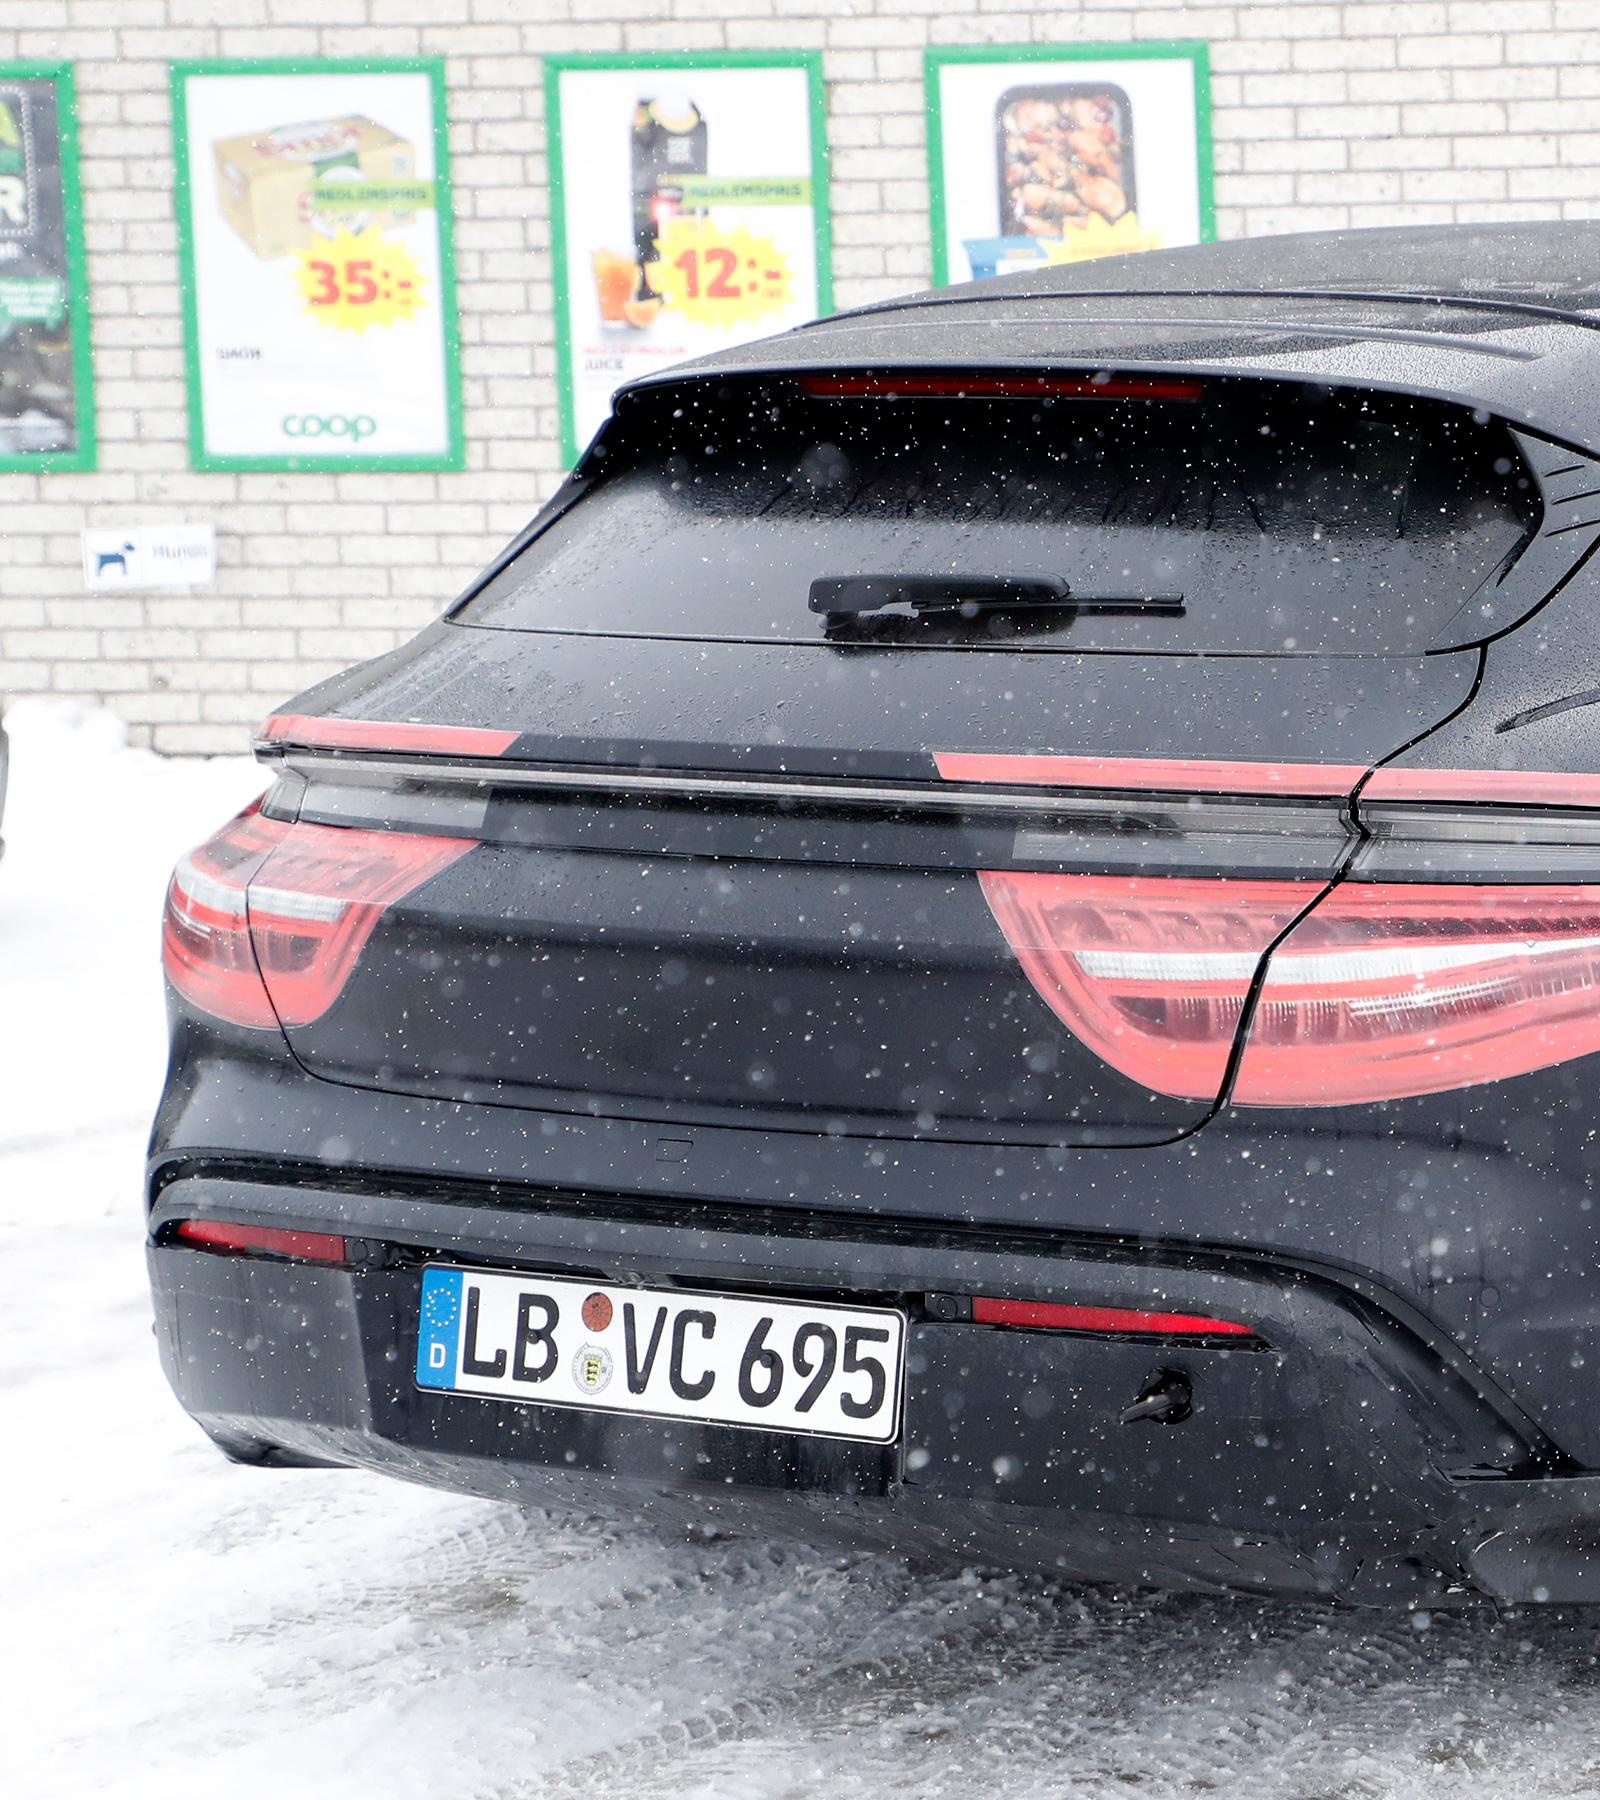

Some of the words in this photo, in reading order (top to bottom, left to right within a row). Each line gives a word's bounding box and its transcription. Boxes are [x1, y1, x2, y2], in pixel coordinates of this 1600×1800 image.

[282, 414, 377, 442] coop
[427, 1342, 447, 1369] D
[461, 1286, 561, 1384] LB
[622, 1302, 717, 1402] VC
[737, 1316, 890, 1420] 695
